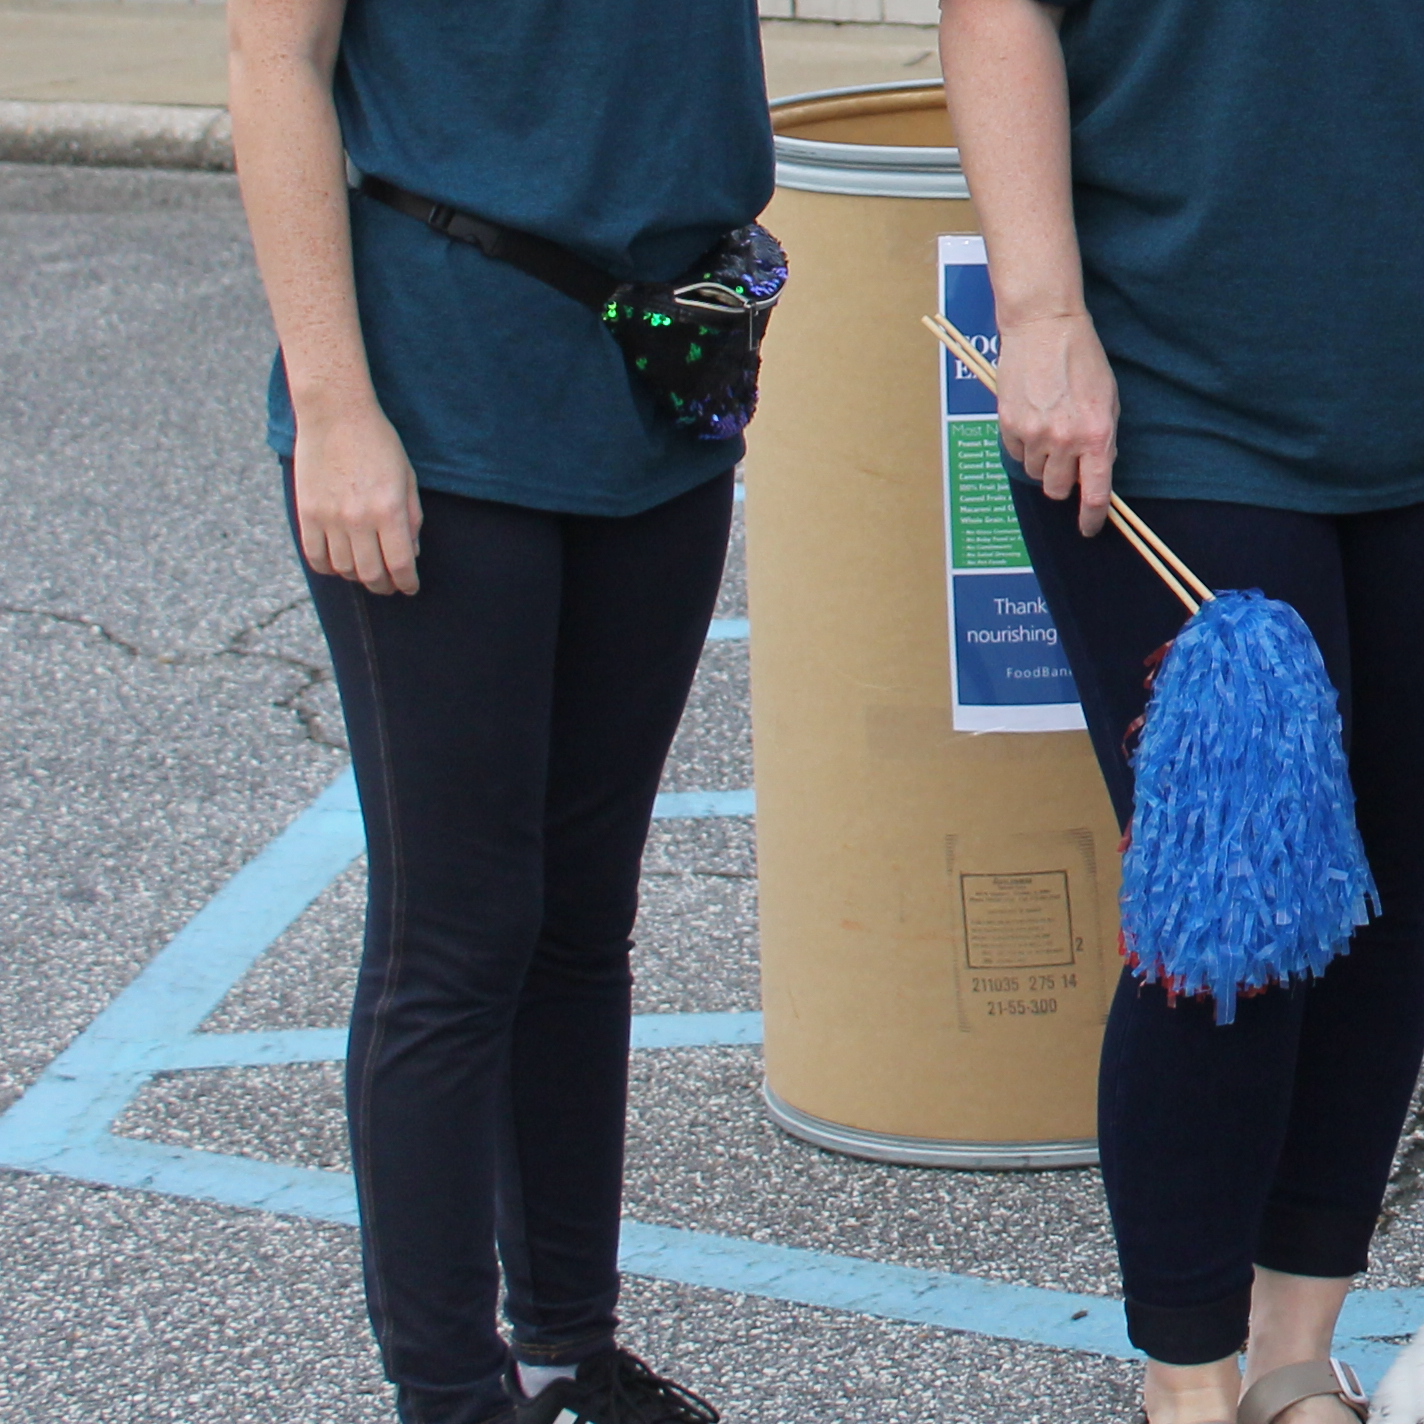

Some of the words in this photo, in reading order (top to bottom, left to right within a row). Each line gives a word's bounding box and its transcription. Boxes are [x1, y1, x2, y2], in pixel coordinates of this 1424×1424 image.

[993, 596, 1048, 615] Thank
[967, 624, 1058, 646] nourishing
[1075, 936, 1084, 952] 2
[972, 977, 1019, 992] 211035
[1029, 975, 1055, 991] 275
[1062, 973, 1077, 989] 14
